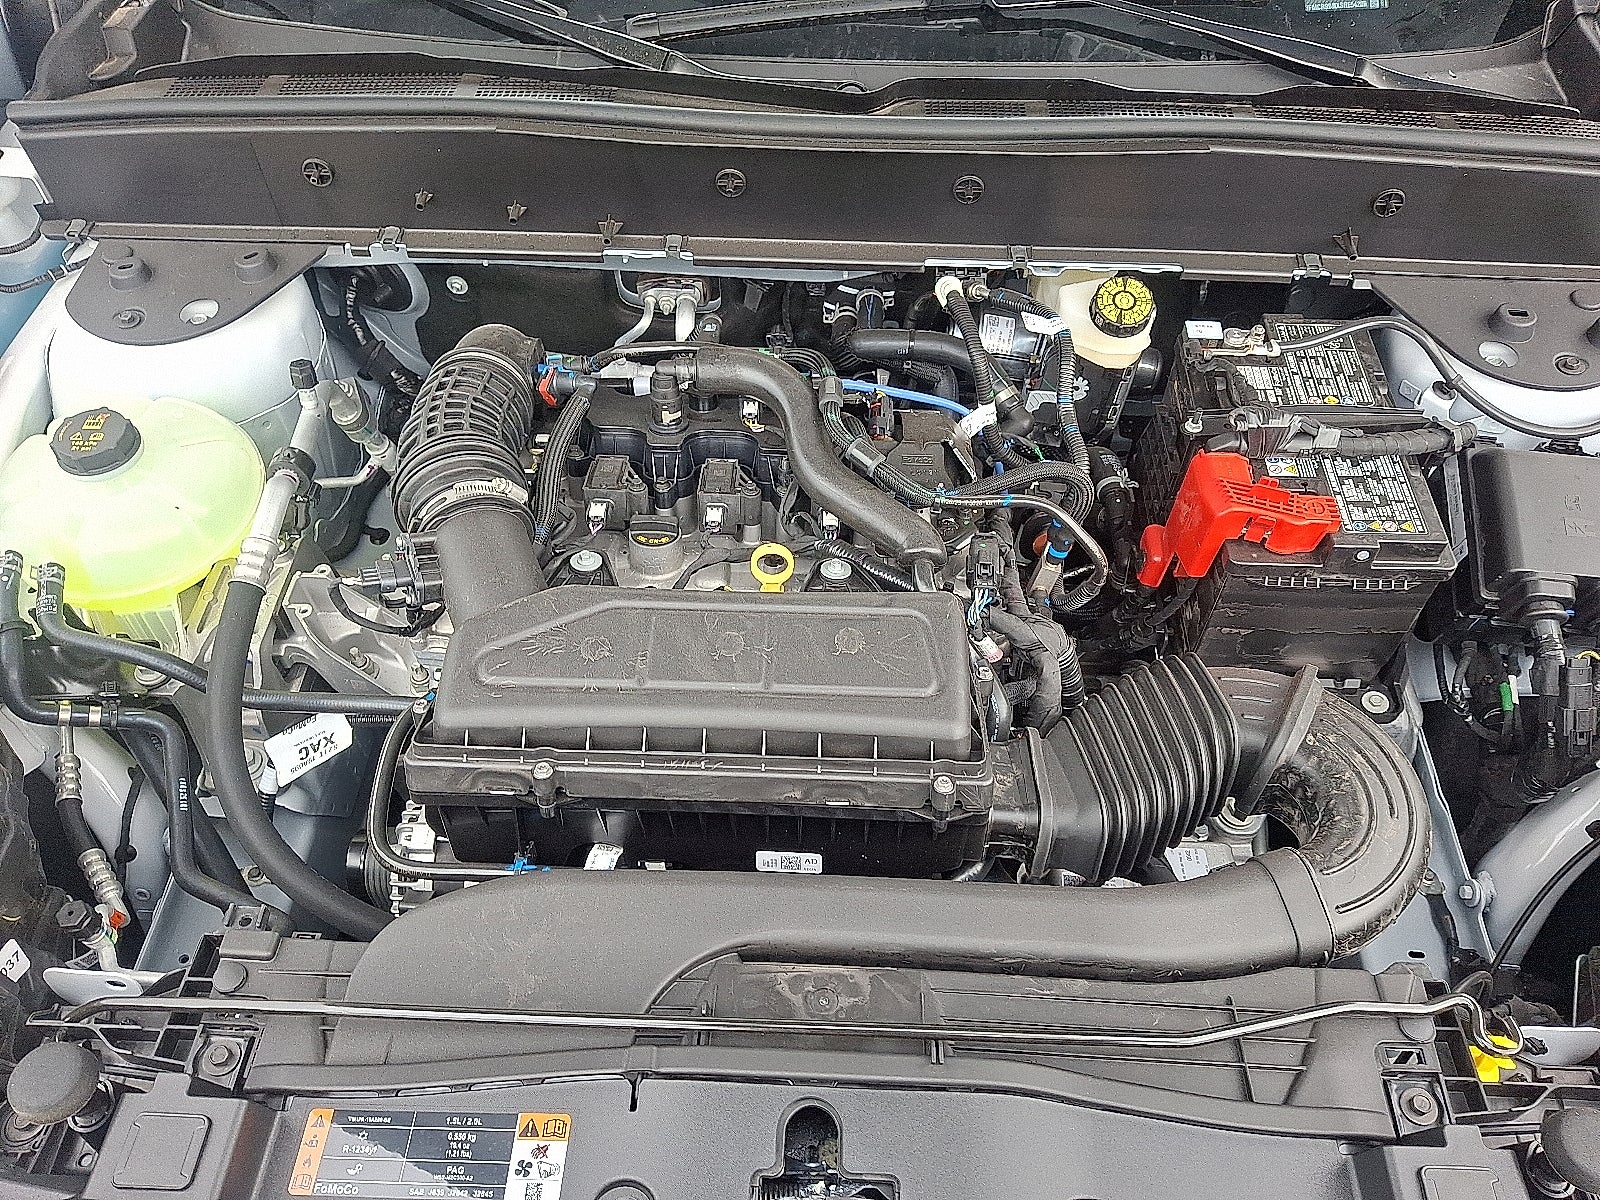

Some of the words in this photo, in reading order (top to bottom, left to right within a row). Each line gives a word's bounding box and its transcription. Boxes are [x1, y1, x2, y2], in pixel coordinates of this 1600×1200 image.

[298, 732, 335, 761] XAC
[445, 1116, 461, 1126] 1.5L
[466, 1117, 483, 1126] 2.0L
[467, 1133, 477, 1143] kg
[342, 1144, 378, 1155] R-1234yf
[446, 1166, 465, 1175] PAG
[313, 1182, 359, 1195] FoMoCo
